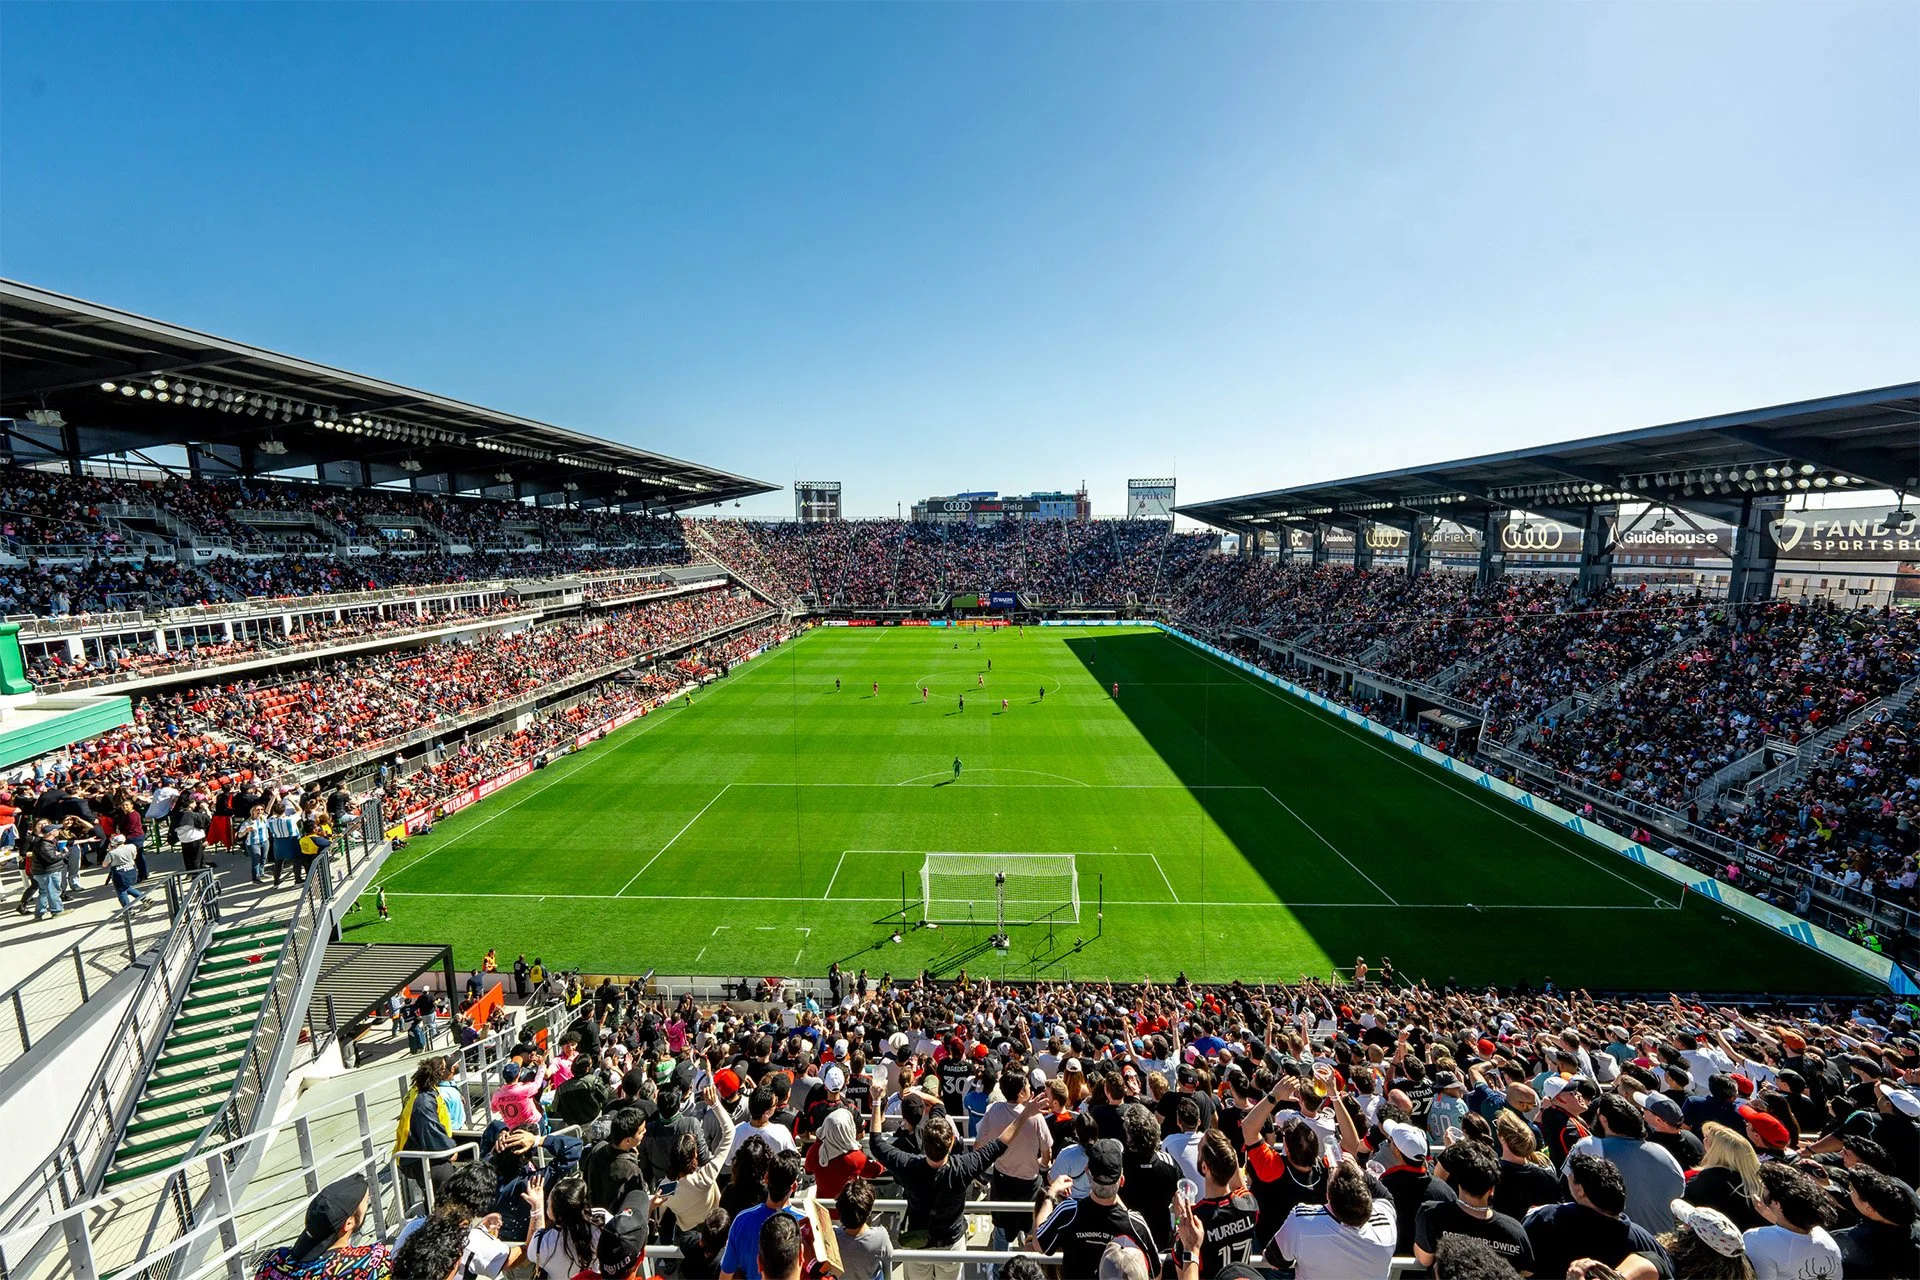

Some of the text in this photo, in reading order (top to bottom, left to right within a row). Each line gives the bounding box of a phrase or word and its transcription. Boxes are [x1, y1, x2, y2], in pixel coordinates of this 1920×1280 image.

[979, 502, 1023, 511] Audi Field
[1291, 533, 1302, 546] DC
[1624, 530, 1718, 544] Guidehouse
[1747, 851, 1774, 865] SUPPORT
[1745, 864, 1757, 873] NOT
[499, 1103, 518, 1118] 10
[1411, 1097, 1433, 1115] 27
[977, 1215, 990, 1232] 15
[1207, 1216, 1254, 1242] MURRELL
[1218, 1238, 1252, 1268] 17
